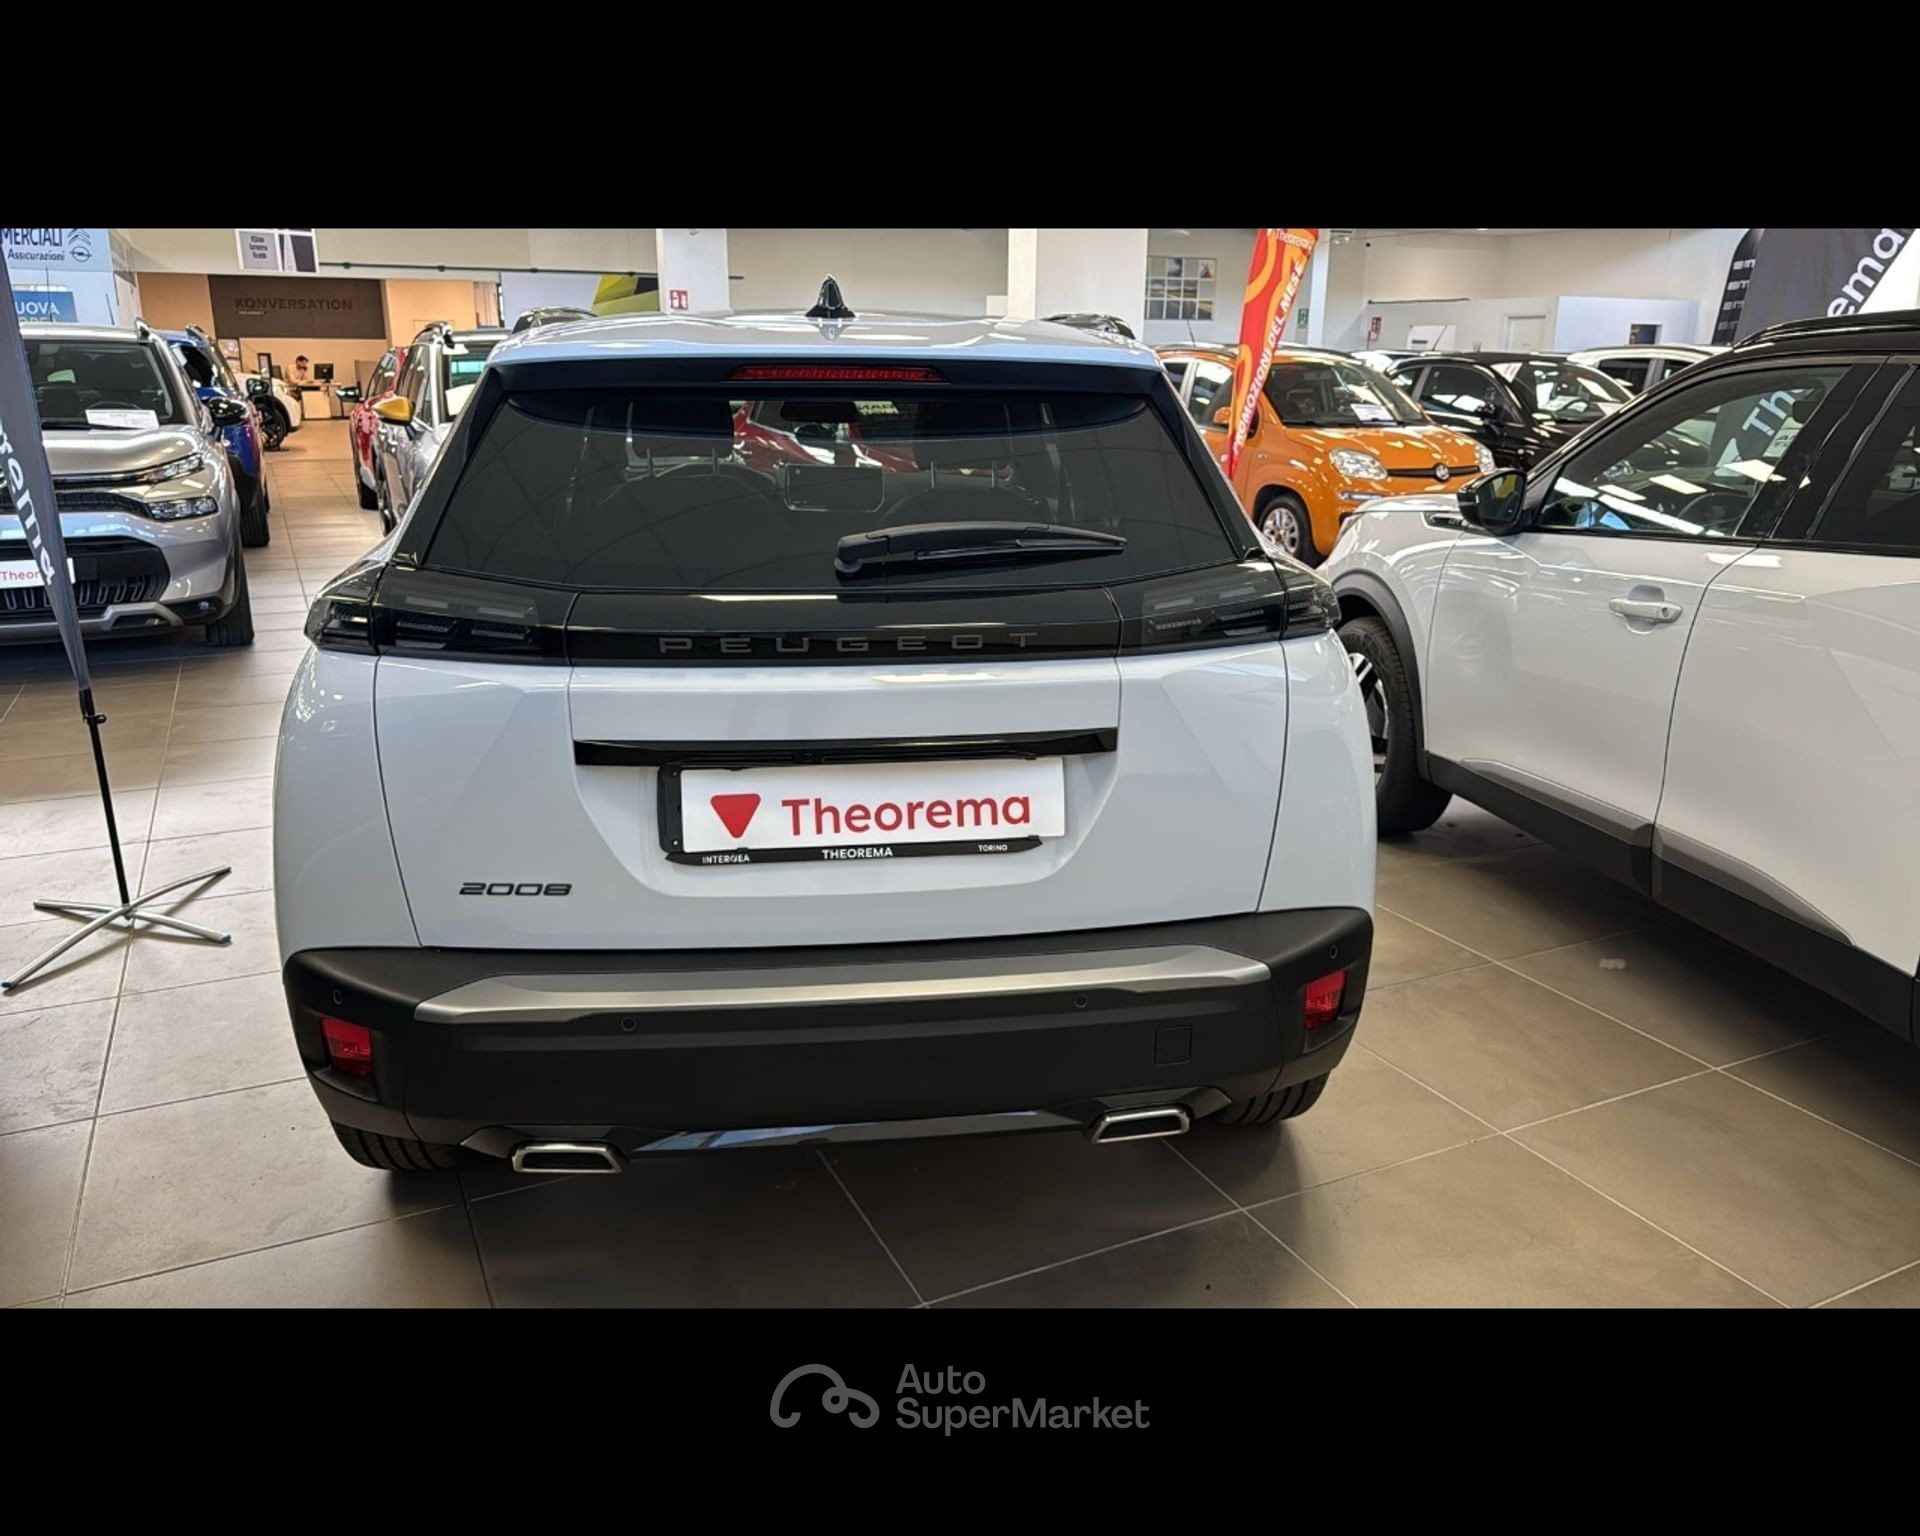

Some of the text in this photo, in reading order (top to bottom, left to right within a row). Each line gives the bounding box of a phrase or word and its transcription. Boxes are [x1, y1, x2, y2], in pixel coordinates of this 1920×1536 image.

[8, 249, 65, 260] Assicurazioni
[235, 298, 353, 311] KONVERSATION
[1268, 315, 1285, 350] DEL
[1280, 260, 1305, 313] MESE
[659, 632, 1038, 654] PEUGEOT
[781, 795, 1031, 837] Theorema
[822, 847, 893, 860] THEOREMA
[978, 844, 1008, 853] TORINO
[459, 882, 573, 896] 2008
